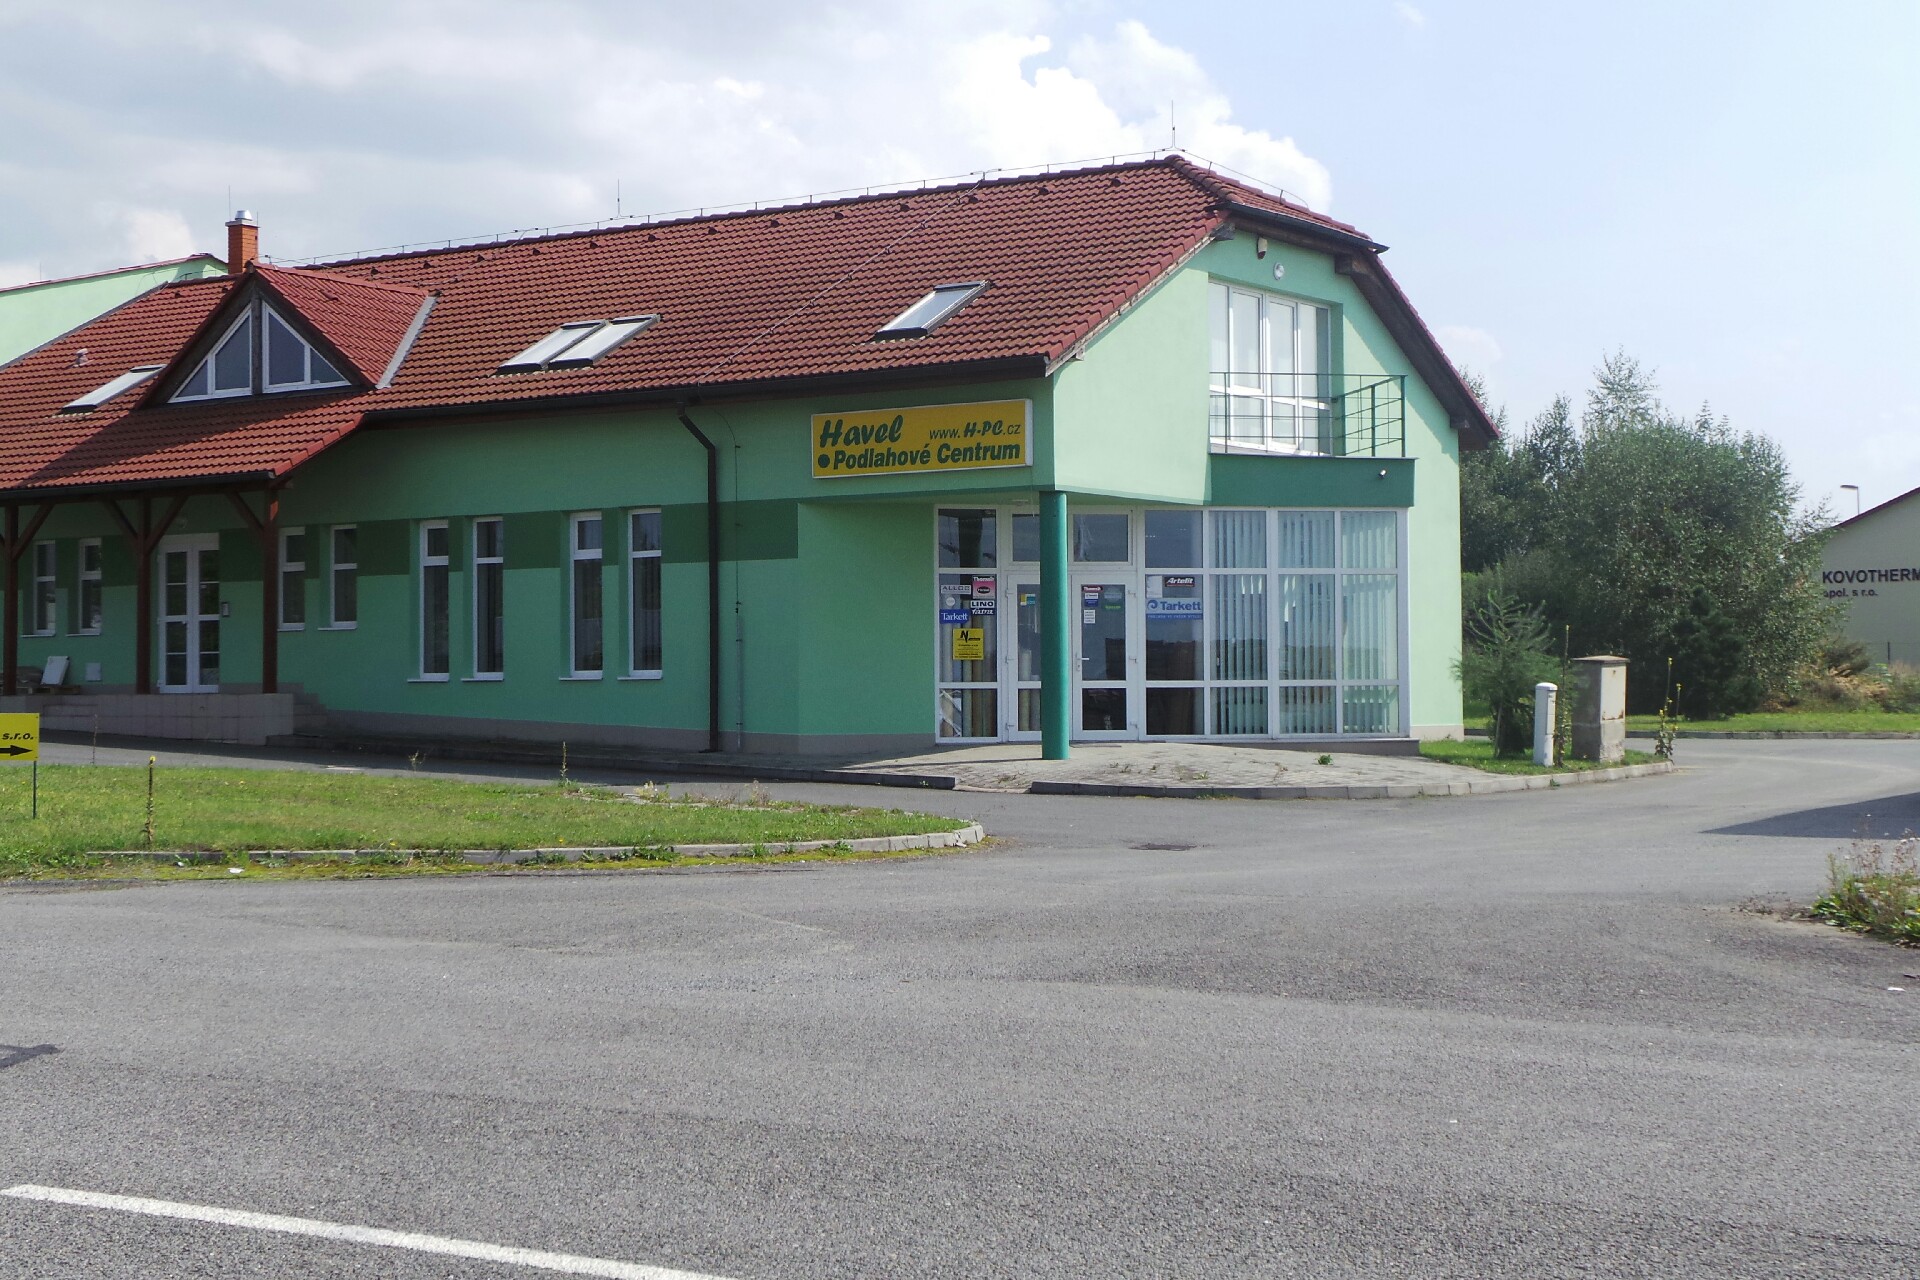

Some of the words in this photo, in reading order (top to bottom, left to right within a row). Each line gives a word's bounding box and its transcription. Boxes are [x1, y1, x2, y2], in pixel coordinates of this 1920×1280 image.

[819, 414, 904, 448] Havel
[833, 443, 931, 470] Podlahové
[937, 443, 1020, 464] Centrum
[1160, 601, 1201, 611] Tarkett
[941, 612, 968, 621] Tarkett
[2, 732, 34, 740] s.r.o.
